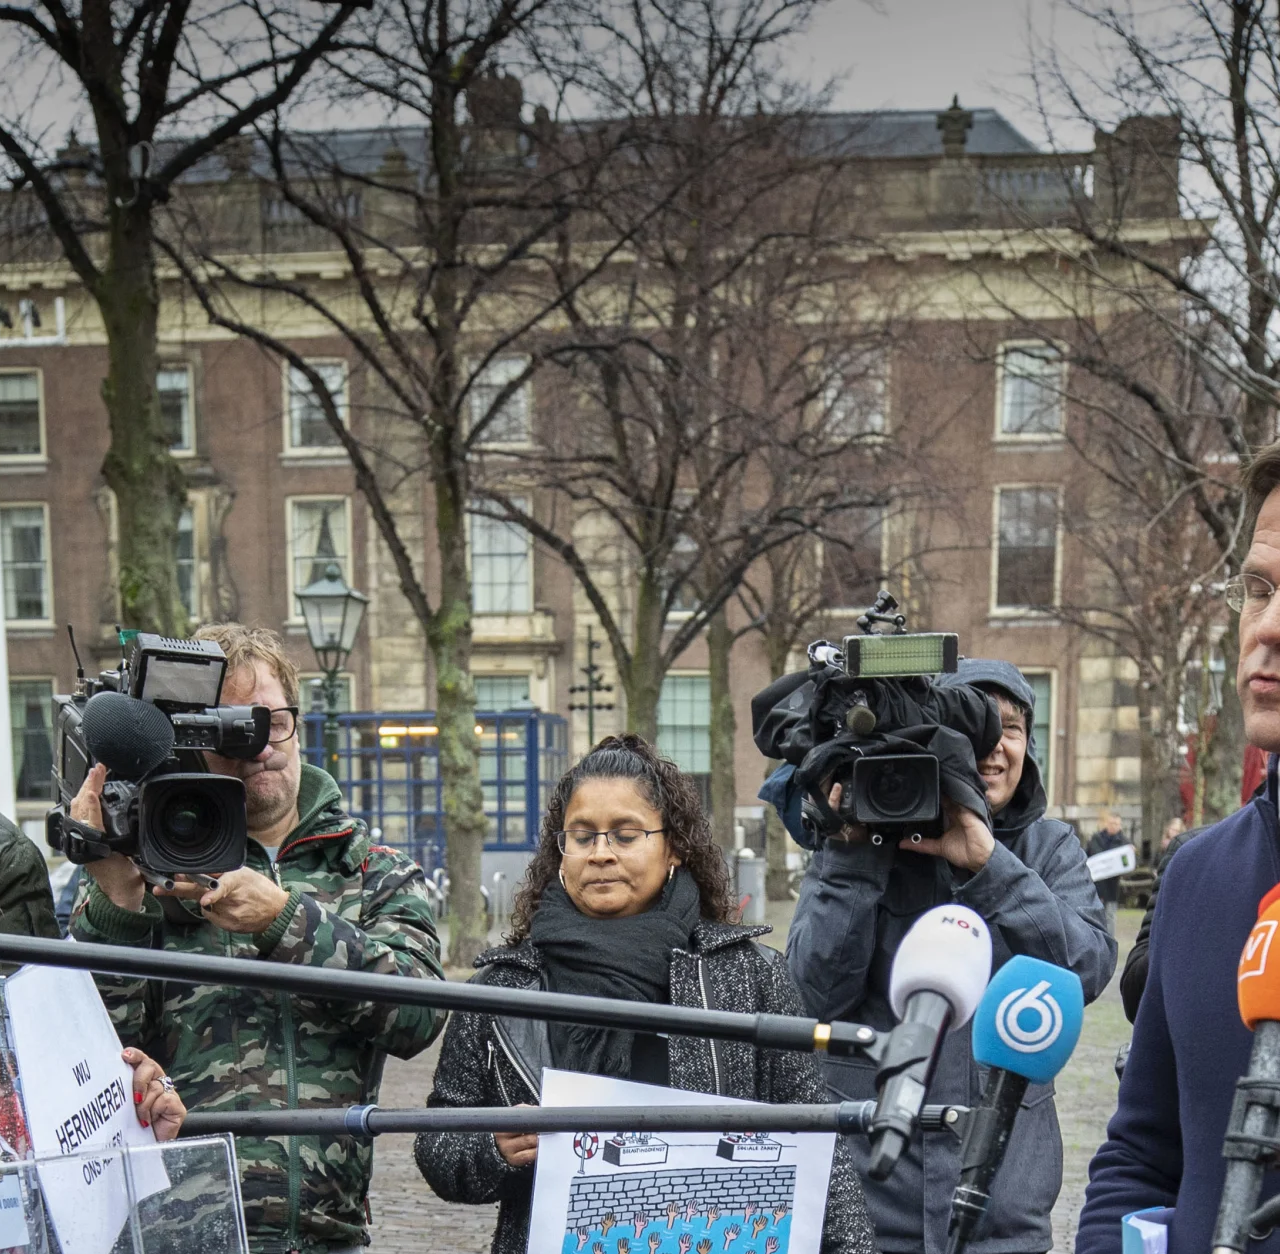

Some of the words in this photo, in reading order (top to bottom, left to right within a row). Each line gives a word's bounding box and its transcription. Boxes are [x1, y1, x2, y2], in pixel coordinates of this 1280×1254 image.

[942, 916, 980, 938] NOS
[999, 980, 1060, 1050] 6
[72, 1059, 92, 1087] WIJ
[55, 1077, 126, 1155] HERINNEREN
